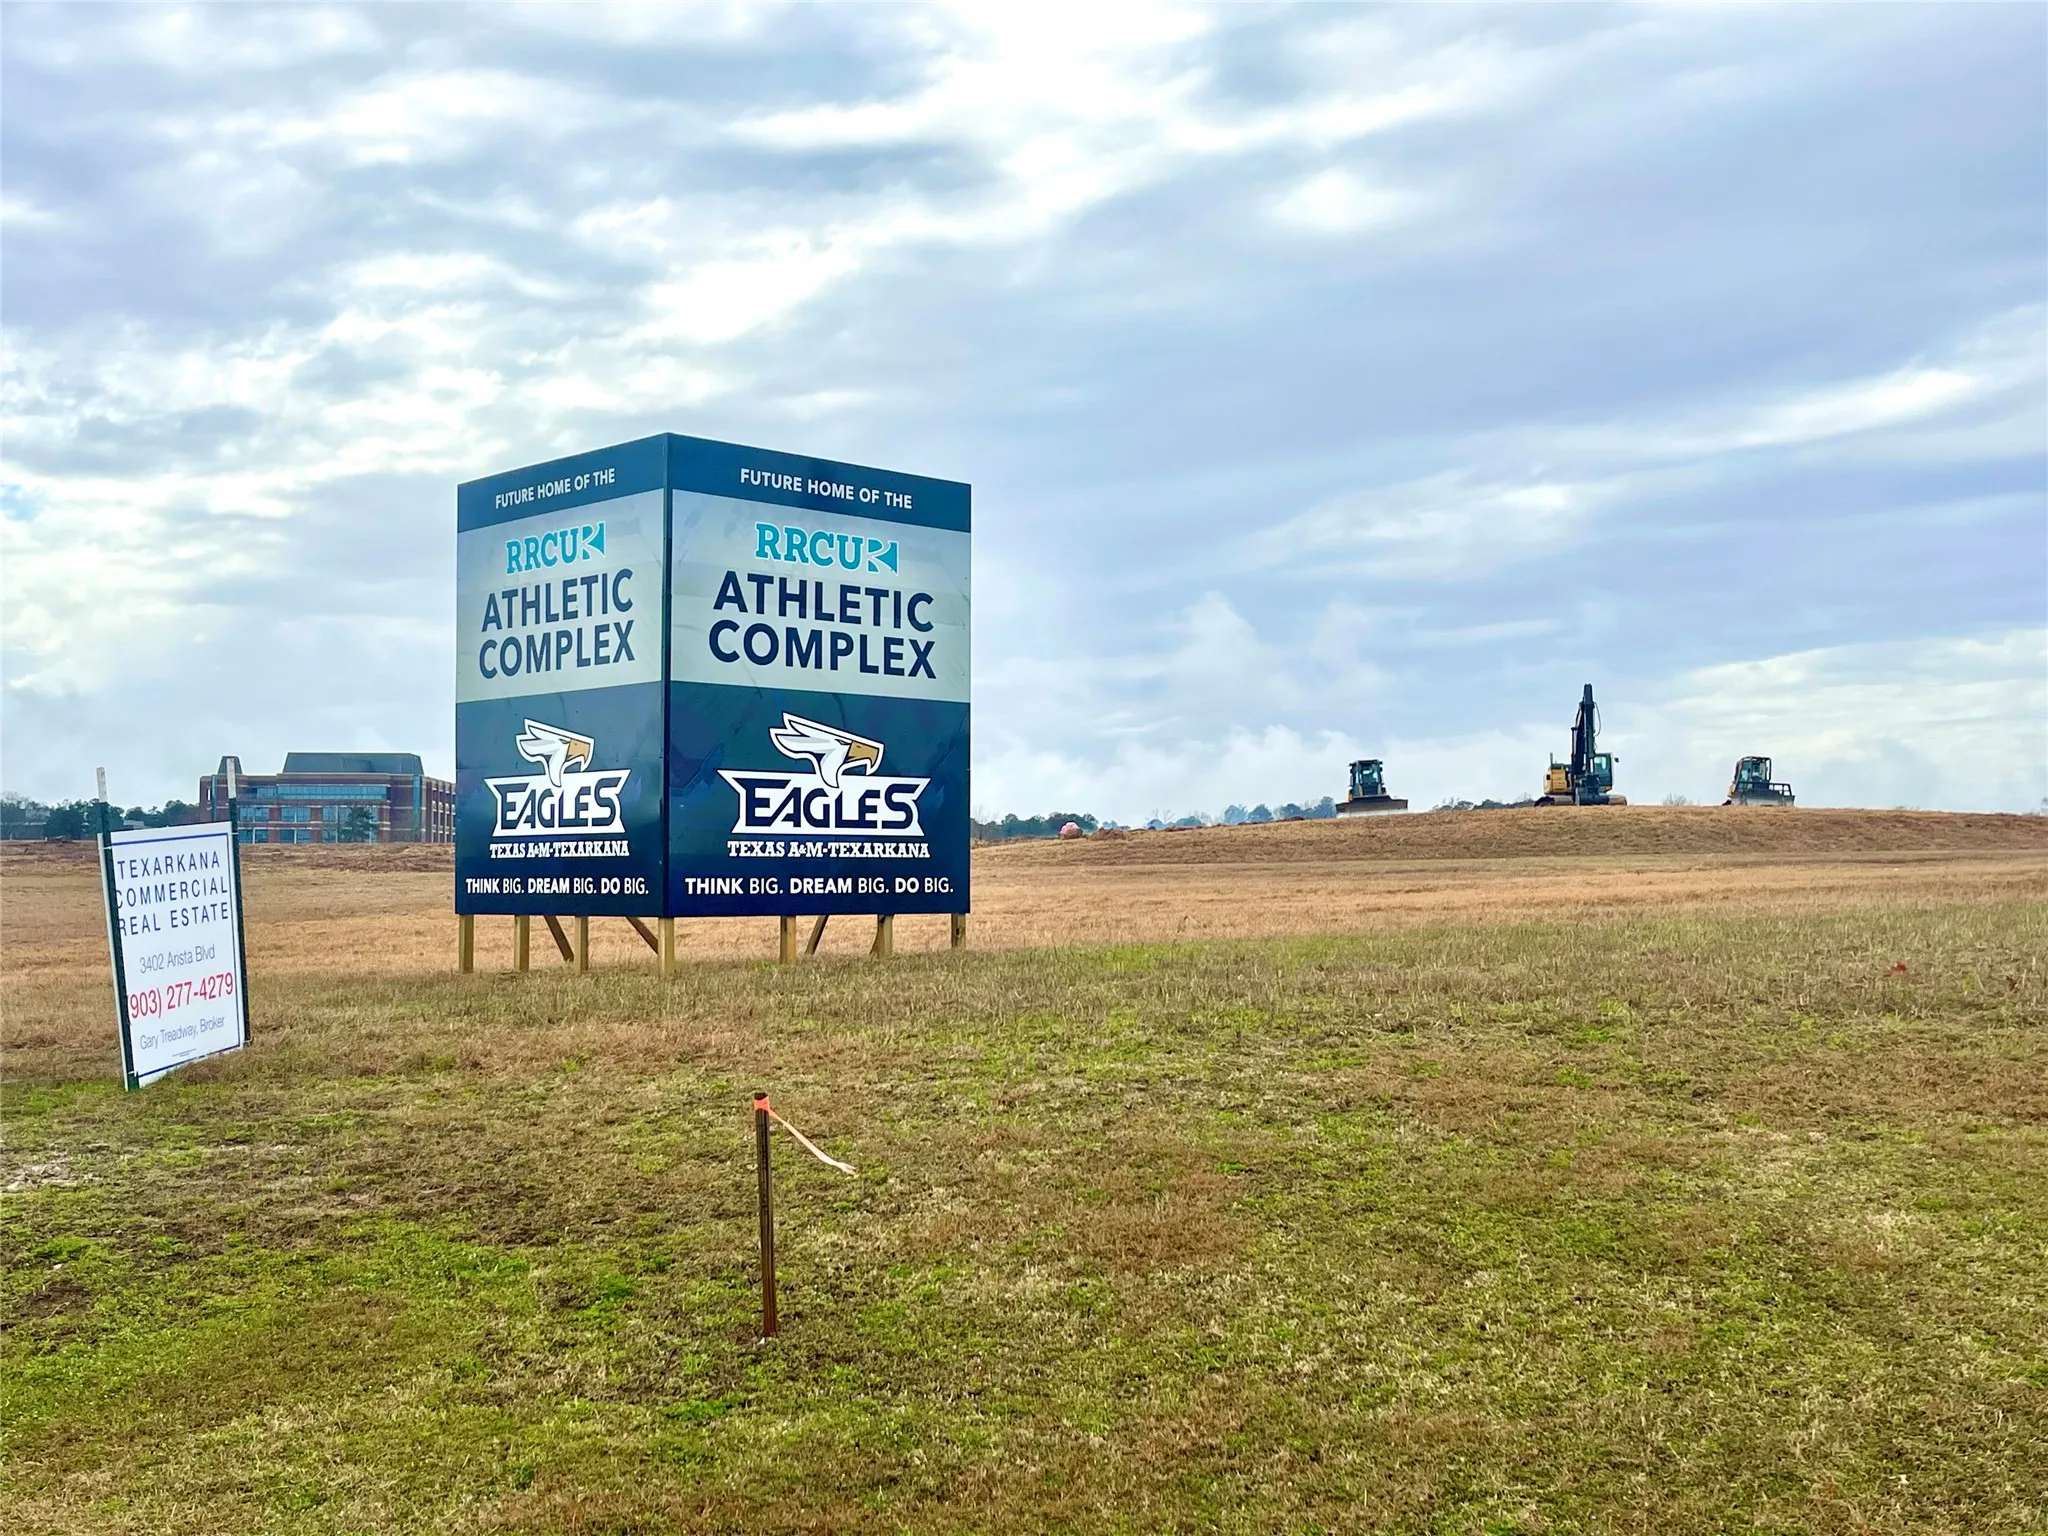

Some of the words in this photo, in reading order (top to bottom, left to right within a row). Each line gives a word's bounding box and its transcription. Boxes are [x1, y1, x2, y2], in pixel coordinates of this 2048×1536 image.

[495, 486, 535, 509] FUTURE
[537, 477, 571, 500] HOME
[574, 473, 591, 491] OF
[592, 468, 616, 487] THE
[740, 468, 803, 492] FUTURE
[807, 479, 855, 500] HOME
[859, 487, 880, 504] OF
[884, 491, 912, 509] THE
[481, 568, 634, 633] ATHLETIC
[713, 570, 935, 632] ATHLETIC
[479, 619, 635, 679] COMPLEX
[709, 619, 937, 680] COMPLEX
[493, 776, 623, 830] EAGLES
[732, 777, 922, 830] EAGLES
[117, 851, 220, 879] TEXARKANA
[490, 842, 525, 858] TEXAS
[727, 840, 785, 858] TEXAS
[115, 876, 228, 909] COMMERCIAL
[465, 877, 500, 894] THINK
[502, 877, 525, 894] BIG.
[527, 877, 570, 894] DREAM
[573, 877, 597, 894] BIG.
[600, 877, 621, 894] DO
[624, 877, 649, 894] BIG.
[685, 877, 744, 895] THINK
[749, 877, 784, 895] BIG.
[789, 877, 852, 894] DREAM
[858, 877, 889, 894] BIG.
[895, 877, 920, 894] DO
[924, 876, 954, 893] BIG.
[118, 912, 161, 936] REAL
[170, 902, 229, 928] ESTATE
[139, 953, 165, 974] 3402
[167, 950, 194, 968] Arista
[195, 944, 216, 962] Blvd
[127, 987, 162, 1022] 903)
[166, 972, 234, 1010] 277-4279
[140, 1034, 159, 1050] Gary
[160, 1024, 199, 1045] Treadway,
[200, 1016, 226, 1033] Broker
